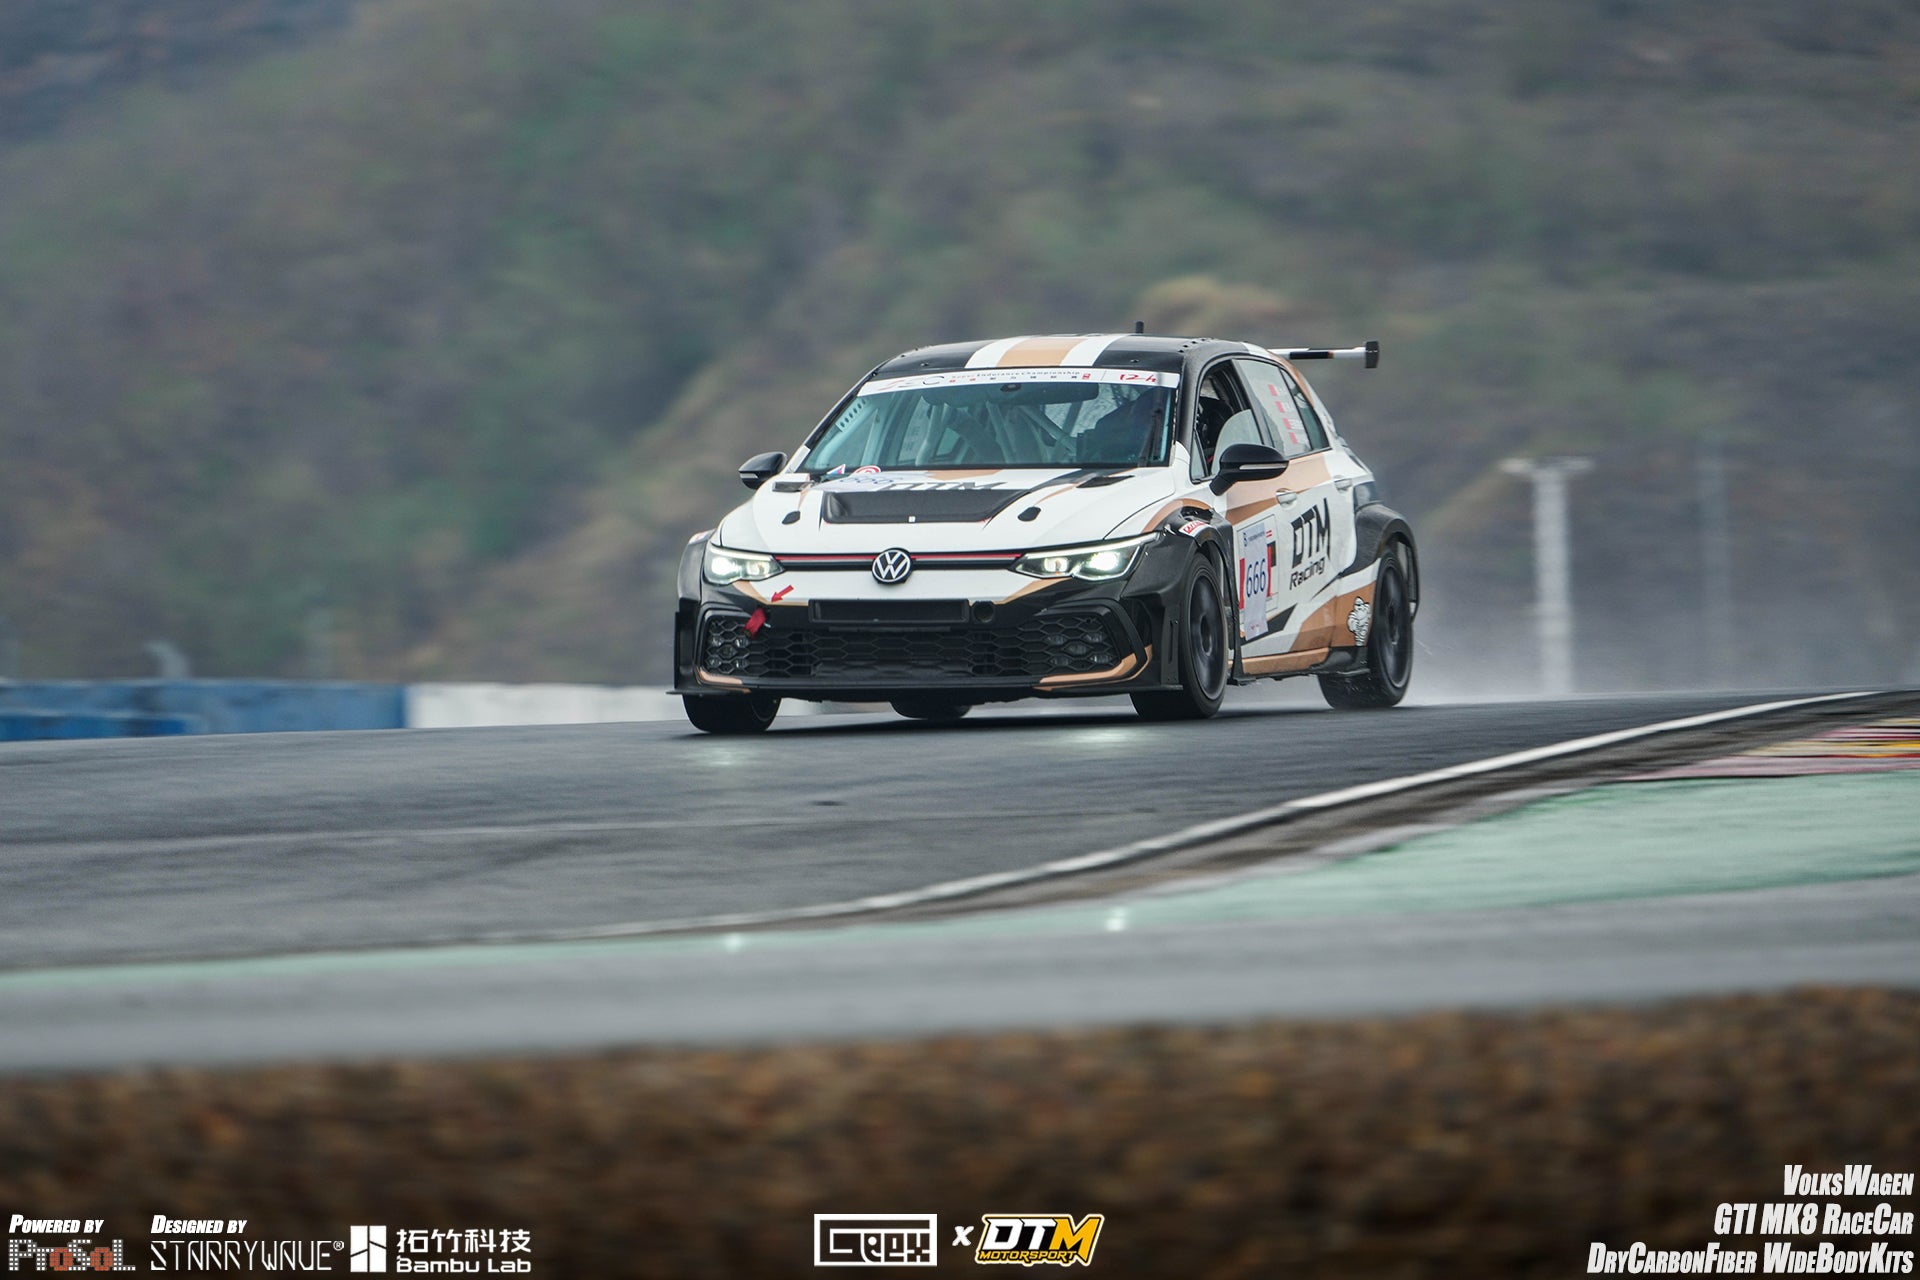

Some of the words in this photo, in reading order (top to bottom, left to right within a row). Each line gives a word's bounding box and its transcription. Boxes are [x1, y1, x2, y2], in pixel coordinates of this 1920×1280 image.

[1290, 497, 1331, 568] DTM
[1246, 558, 1266, 598] 666
[1289, 556, 1326, 591] Racing
